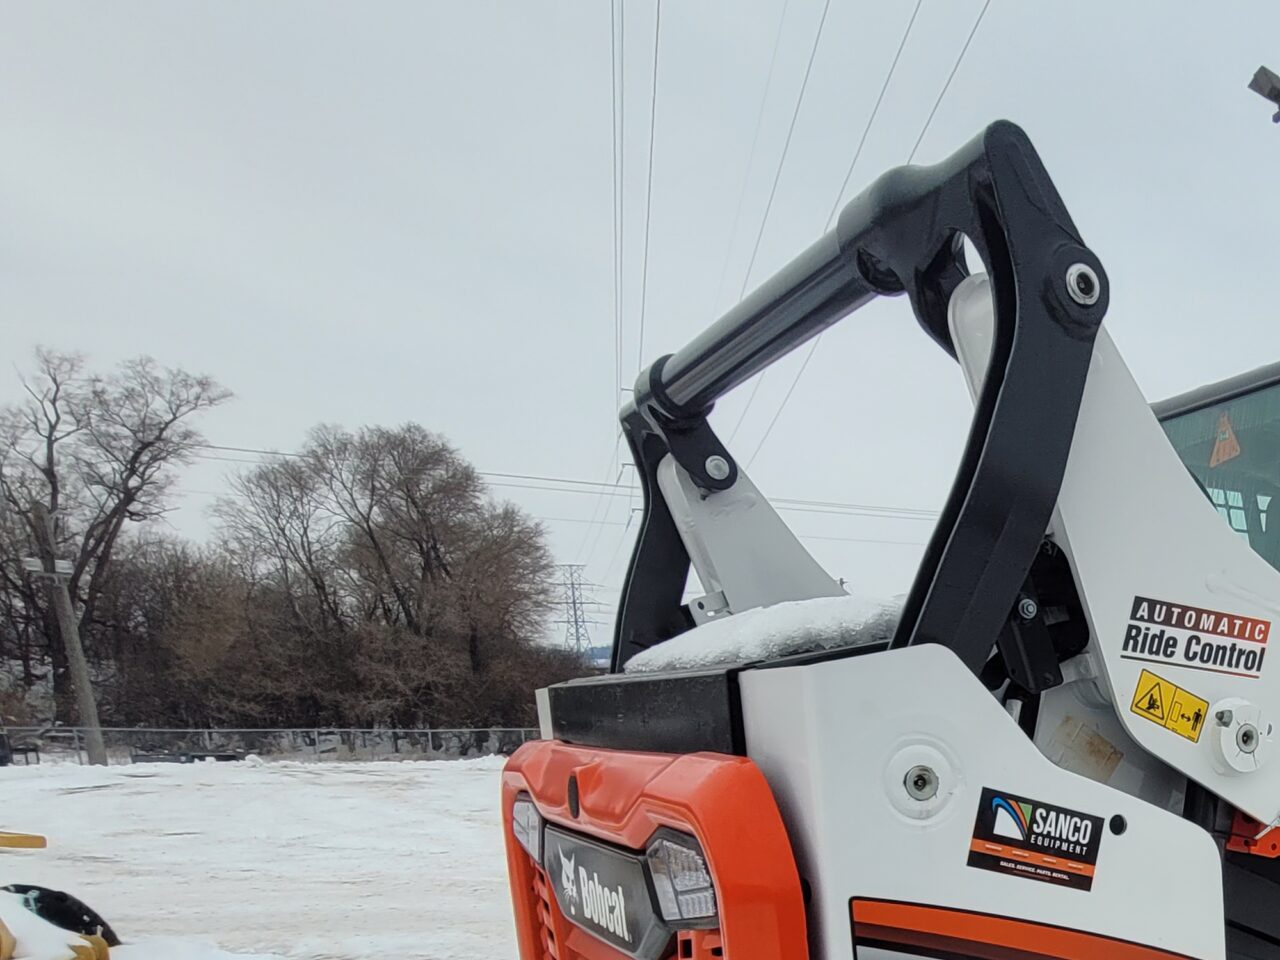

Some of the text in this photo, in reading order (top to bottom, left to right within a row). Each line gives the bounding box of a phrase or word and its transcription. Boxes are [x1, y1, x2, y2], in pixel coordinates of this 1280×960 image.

[1136, 602, 1266, 641] AUTOMATIC
[1122, 624, 1266, 672] Ride Control
[1030, 834, 1088, 856] EQUIPMENT
[1033, 808, 1092, 845] SANCO
[578, 866, 632, 943] Bobcat
